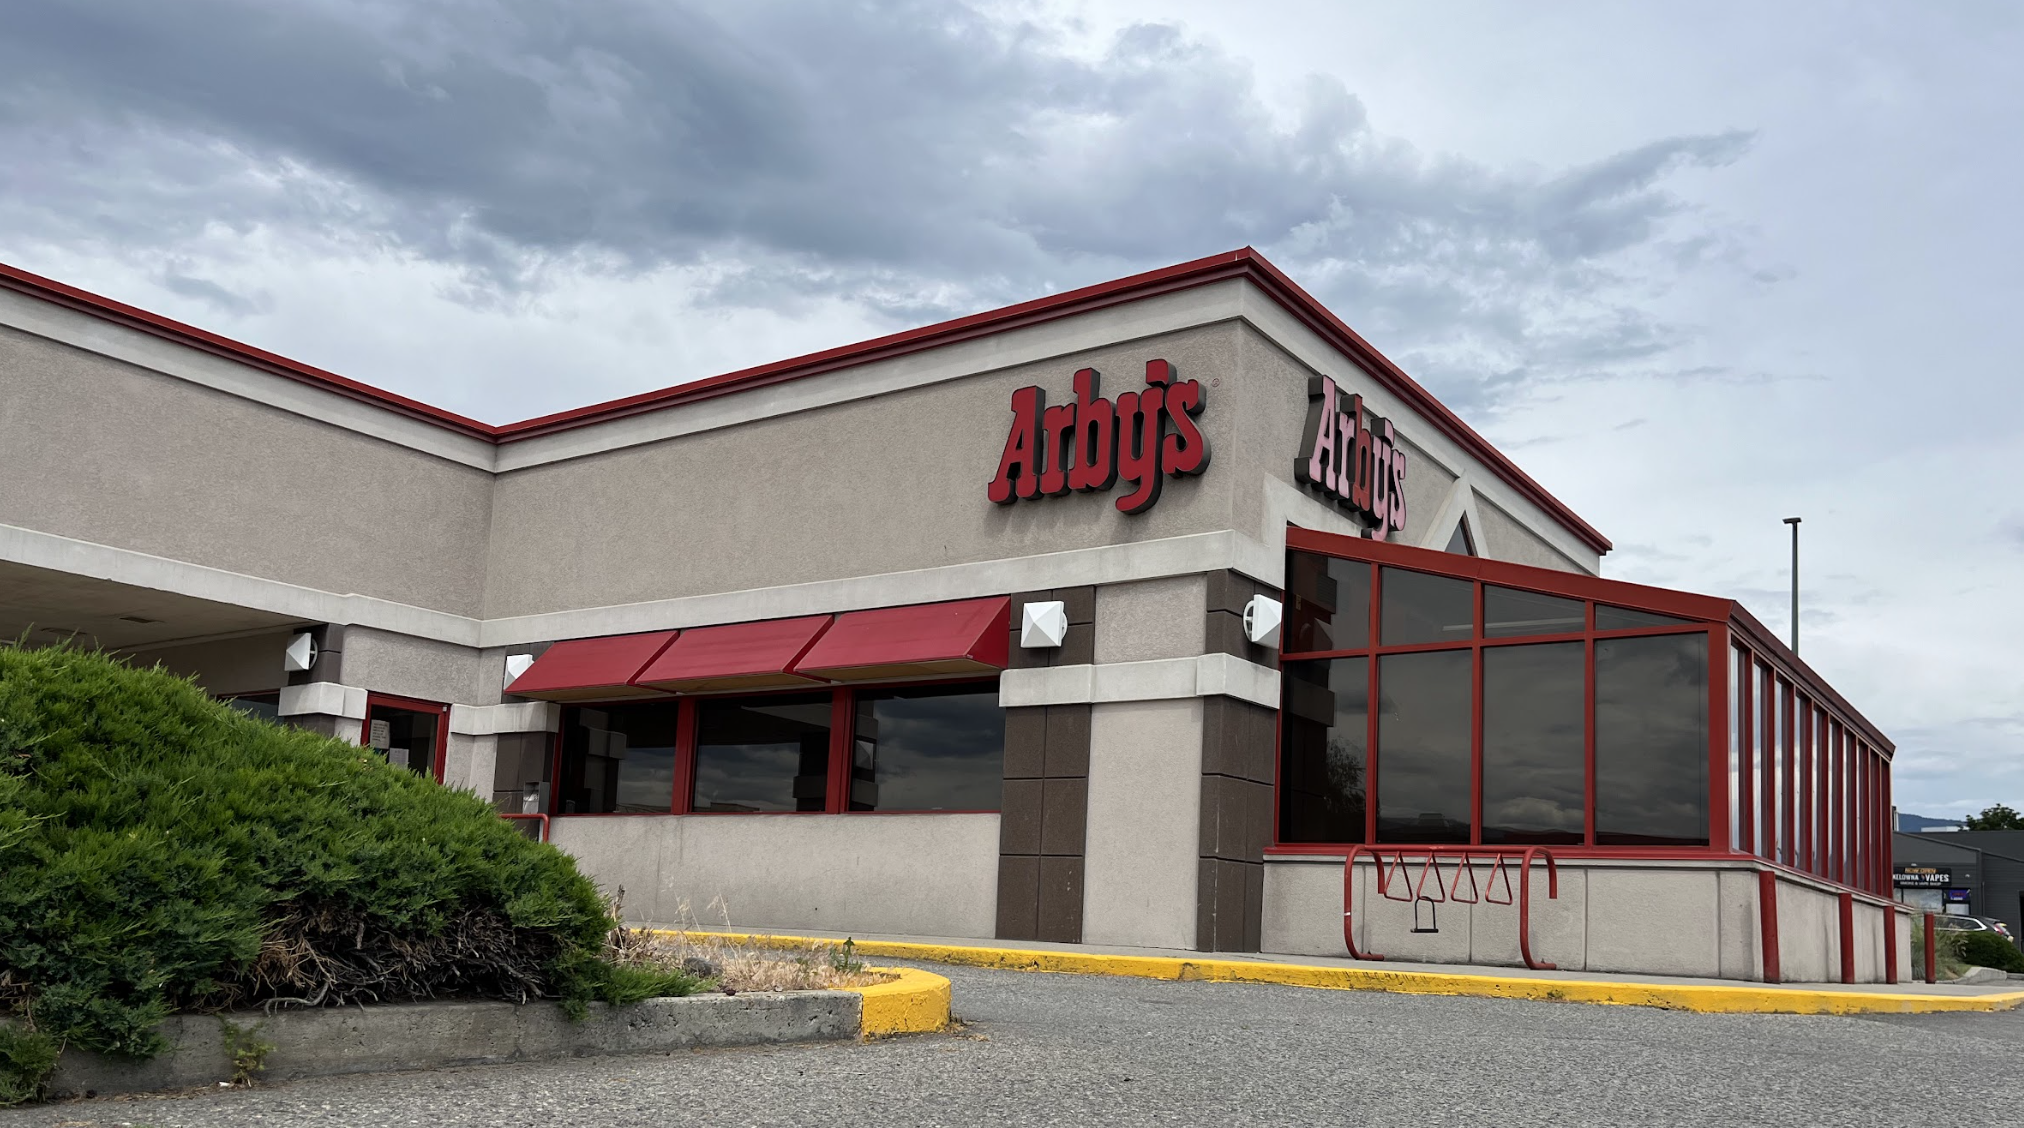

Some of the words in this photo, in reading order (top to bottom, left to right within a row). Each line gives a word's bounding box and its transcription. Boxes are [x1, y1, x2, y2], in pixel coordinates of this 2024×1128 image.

[988, 359, 1210, 513] Arby's
[1297, 375, 1407, 541] Arby's
[1925, 874, 1949, 882] VAPES
